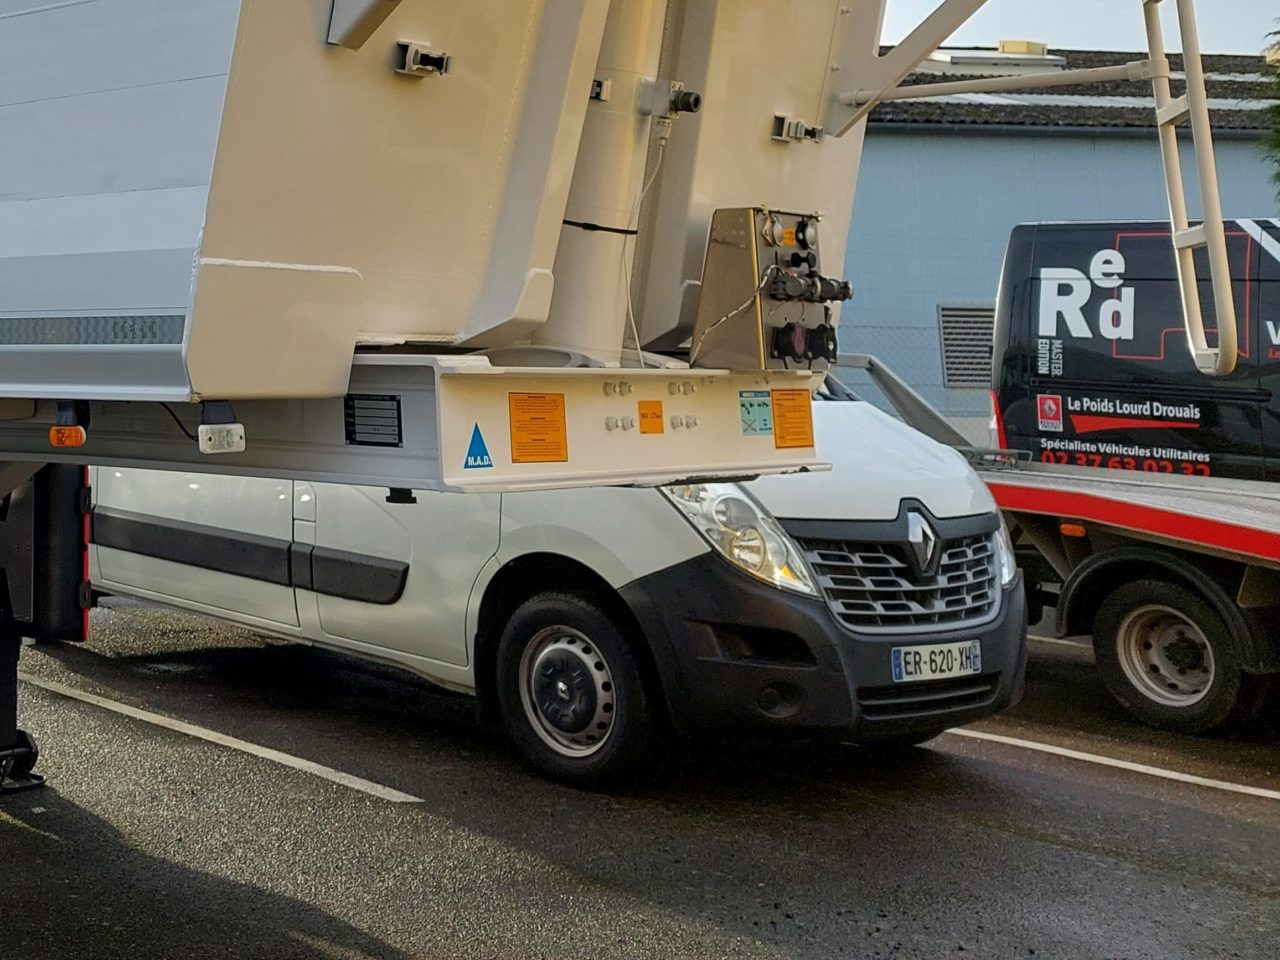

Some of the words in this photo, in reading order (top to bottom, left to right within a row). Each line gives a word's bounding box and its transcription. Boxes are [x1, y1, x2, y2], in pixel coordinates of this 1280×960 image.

[1038, 339, 1050, 375] EDITION
[1051, 339, 1063, 378] MASTER
[1067, 397, 1081, 411] Le
[1083, 398, 1114, 414] Poids
[1117, 400, 1150, 416] Lourd
[1153, 401, 1200, 419] Drouais
[468, 455, 491, 466] M.A.D.
[1040, 438, 1097, 453] Spécialiste
[1098, 442, 1150, 458] Véhicules
[1153, 447, 1210, 463] Utilitaires
